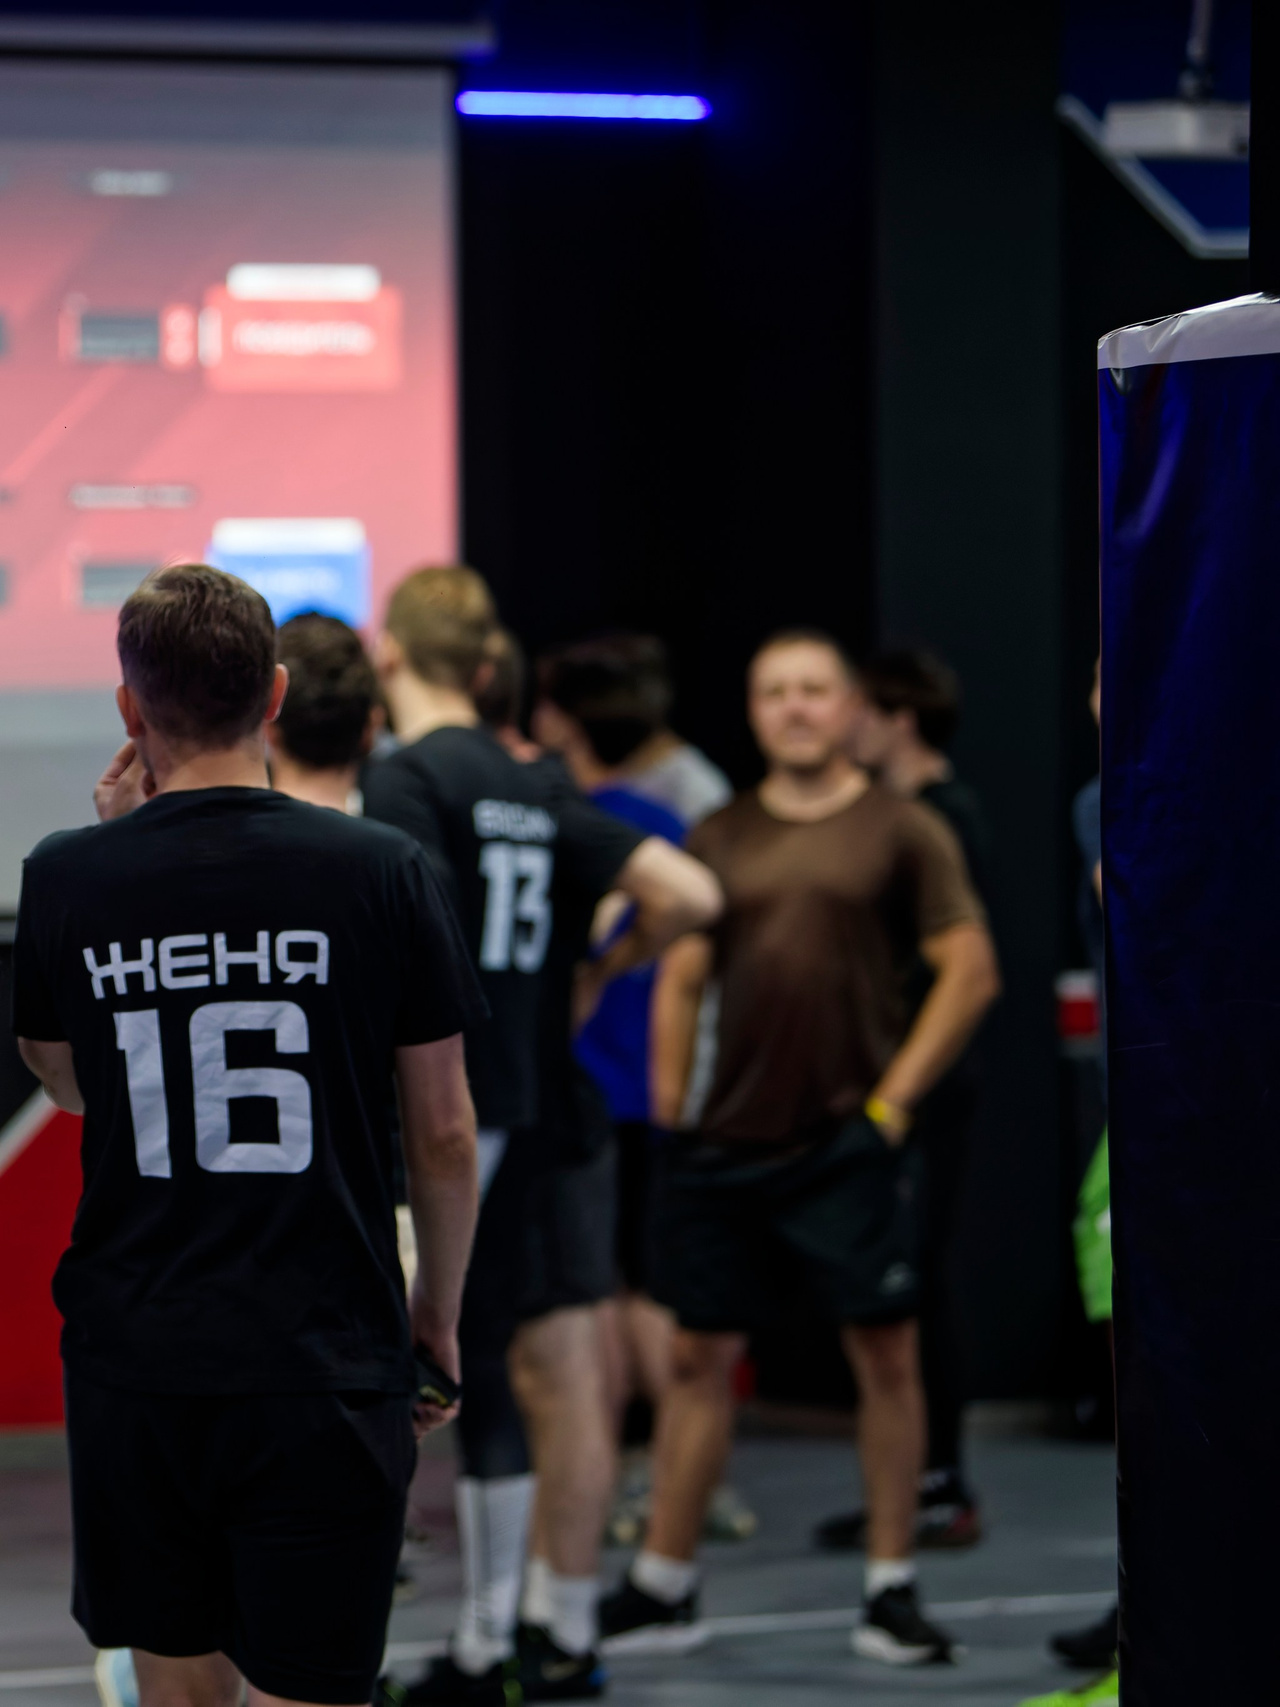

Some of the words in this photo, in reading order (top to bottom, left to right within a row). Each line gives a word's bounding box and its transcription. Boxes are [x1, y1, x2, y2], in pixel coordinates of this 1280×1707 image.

[82, 929, 329, 999] ЖЕНЯ
[480, 842, 552, 971] 13
[112, 1000, 313, 1178] 16
